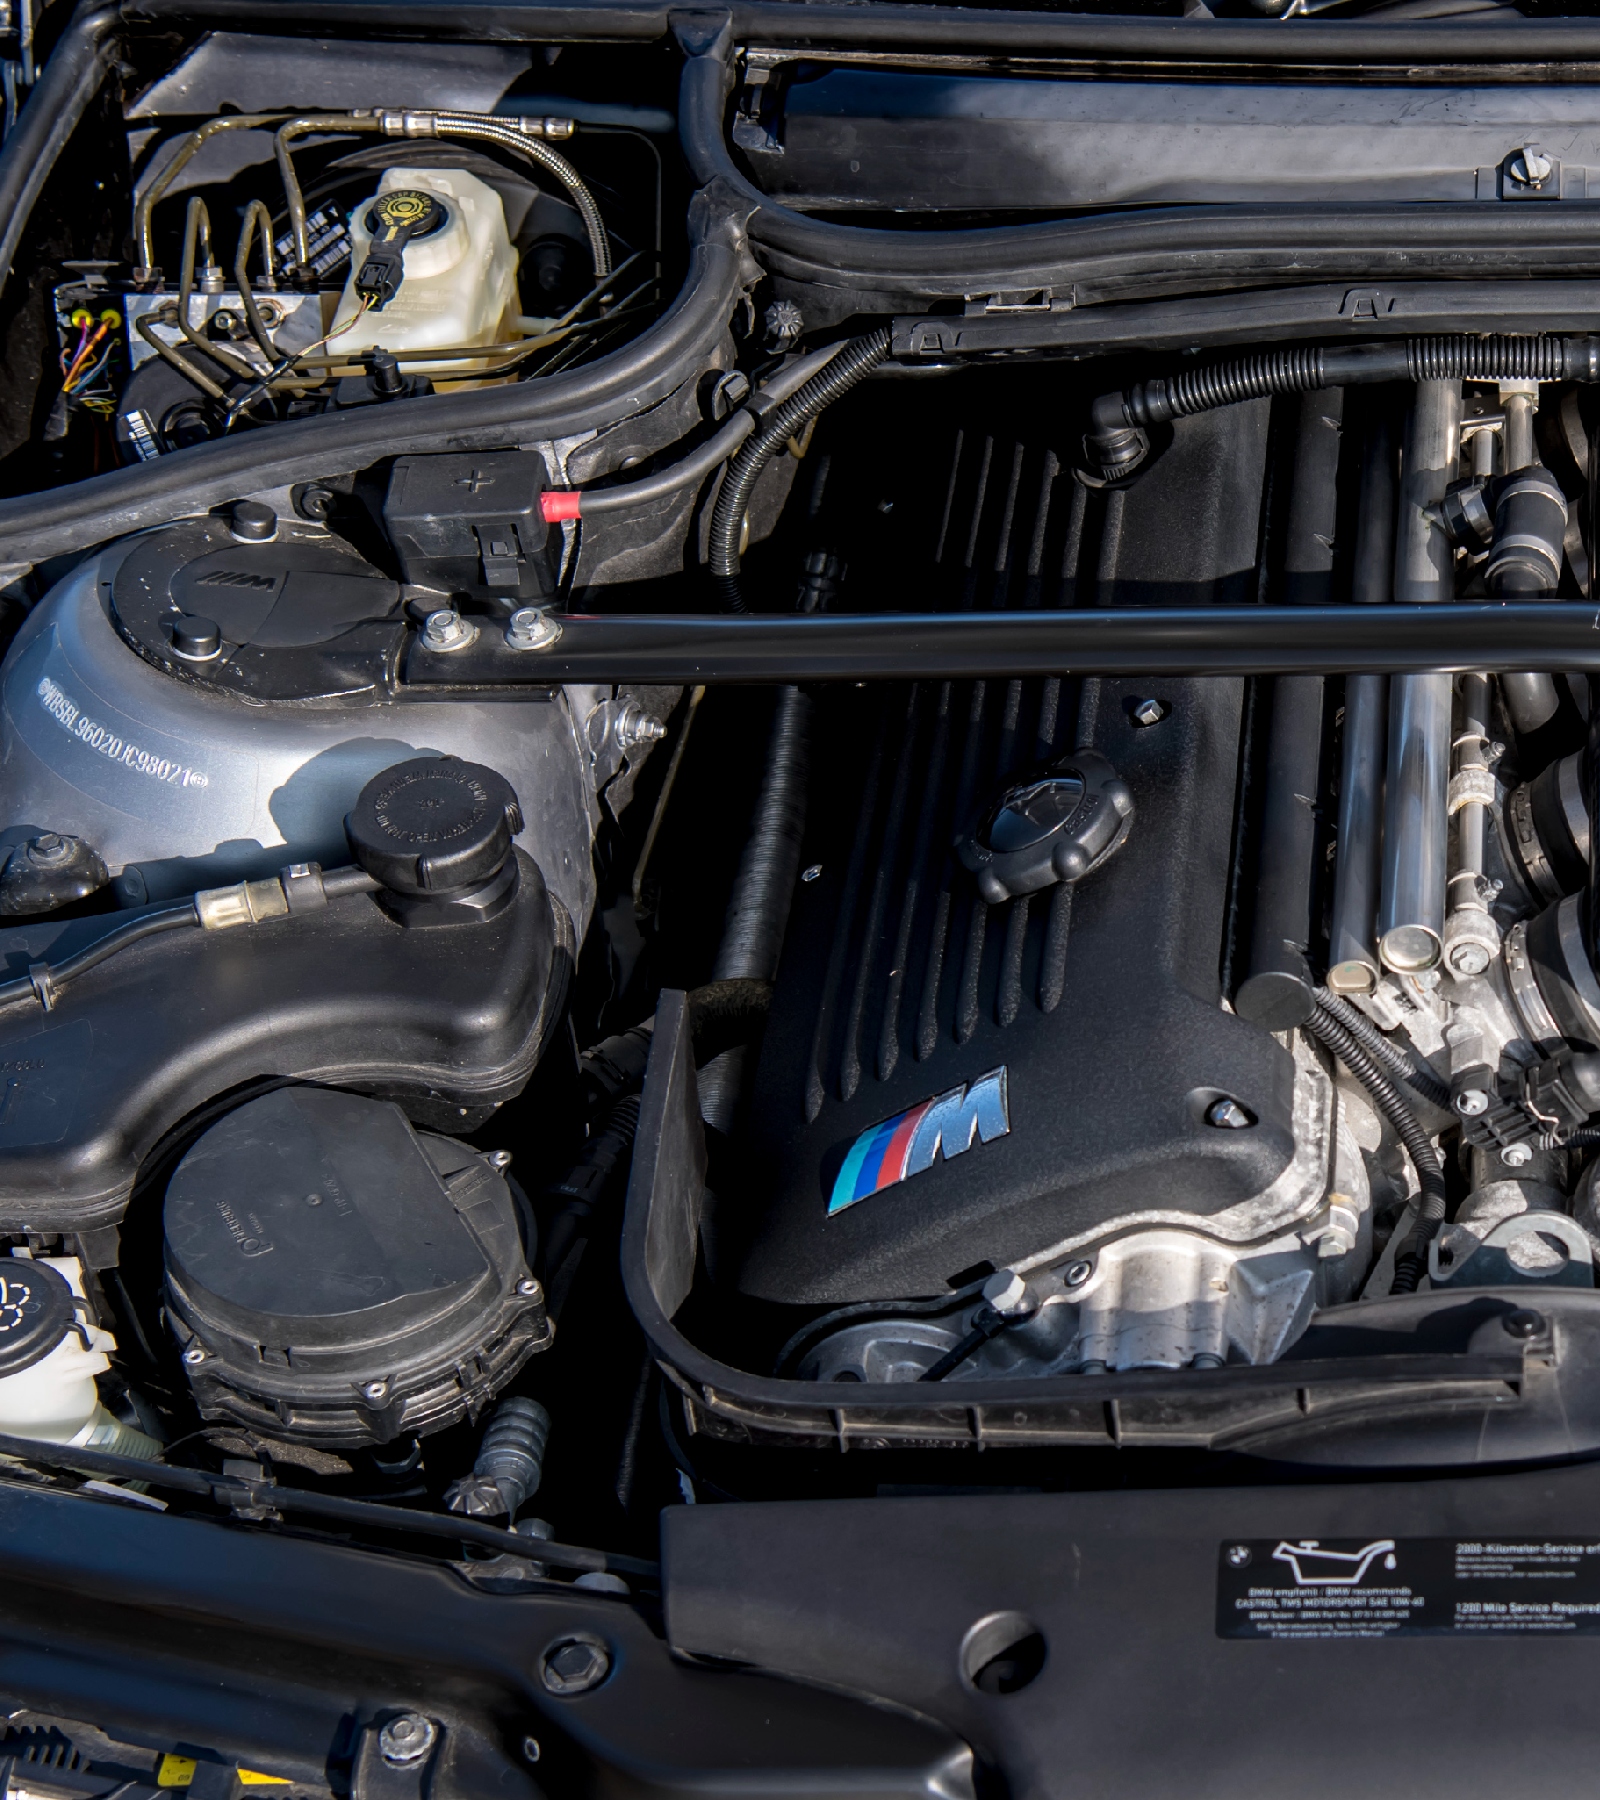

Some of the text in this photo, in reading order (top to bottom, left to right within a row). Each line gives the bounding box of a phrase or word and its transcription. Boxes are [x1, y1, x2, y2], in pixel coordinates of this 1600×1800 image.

[1248, 1587, 1273, 1597] BMW
[1325, 1587, 1351, 1597] BMW
[1235, 1598, 1279, 1609] CASTROL
[1456, 1602, 1481, 1614] 1200
[1482, 1602, 1507, 1613] Mile
[1509, 1602, 1550, 1613] Service
